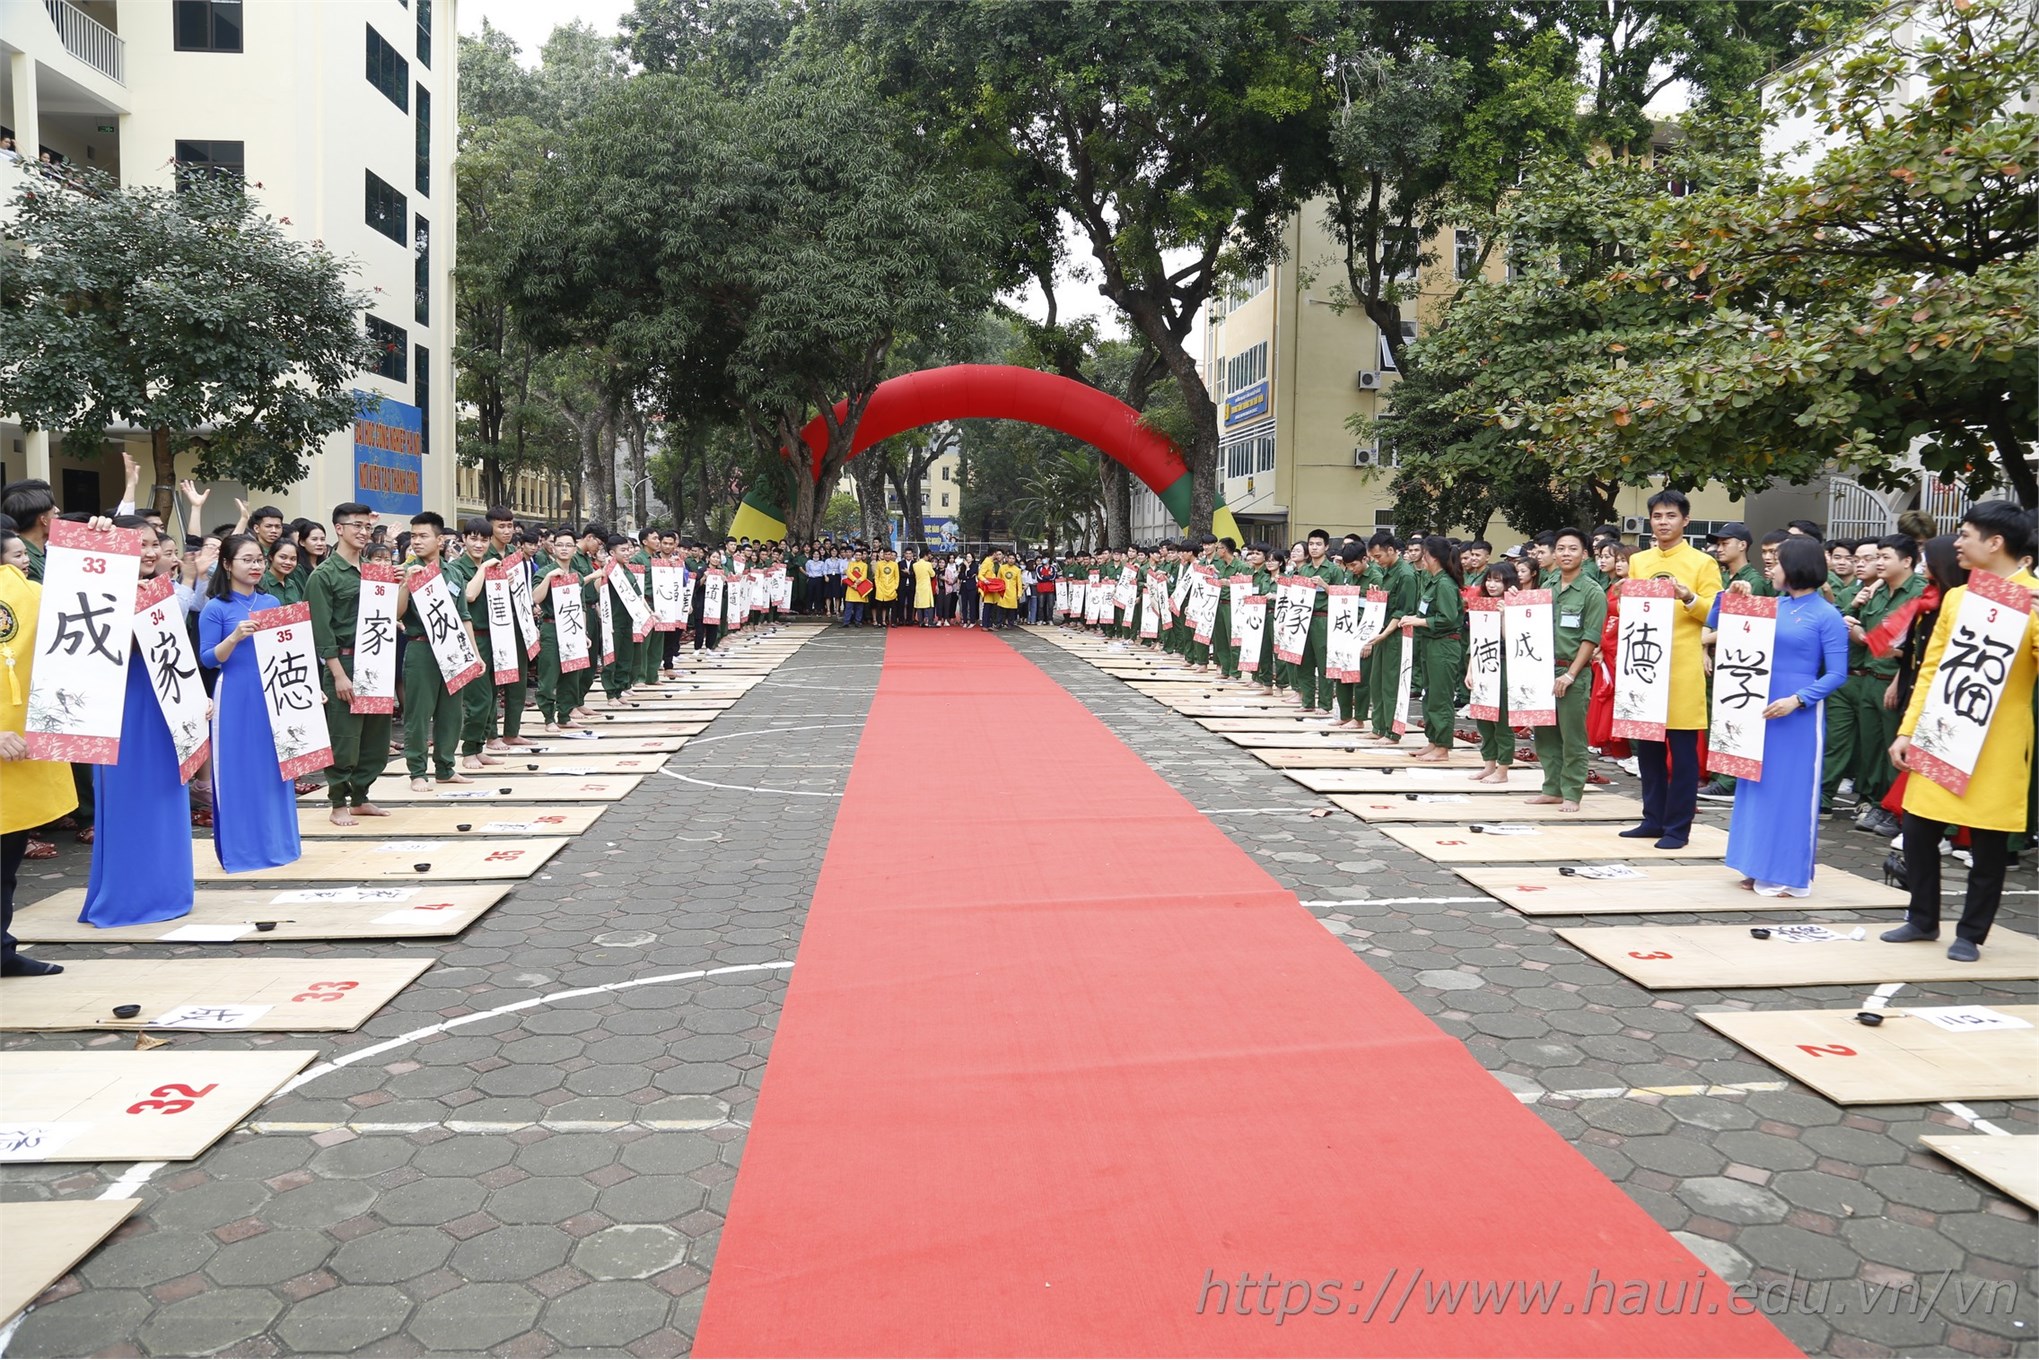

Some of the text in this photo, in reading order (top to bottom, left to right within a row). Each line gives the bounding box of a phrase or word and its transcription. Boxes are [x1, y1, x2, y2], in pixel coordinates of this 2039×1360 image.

[82, 556, 106, 575] 33
[374, 585, 385, 596] 36
[425, 584, 434, 596] 37
[494, 582, 502, 591] 38
[1341, 597, 1348, 605] 10
[1642, 601, 1650, 613] 5
[150, 609, 165, 626] 34
[559, 600, 582, 635] 家
[1483, 613, 1489, 623] 7
[1525, 608, 1532, 618] 6
[1986, 607, 1999, 623] 3
[45, 591, 124, 666] 成
[427, 598, 459, 645] 成
[1246, 615, 1262, 631] 心
[1332, 609, 1354, 635] 成
[1743, 620, 1751, 634] 4
[276, 629, 293, 644] 35
[361, 609, 394, 656] 家
[1514, 631, 1543, 662] 成
[150, 631, 197, 704] 家
[484, 850, 526, 862] 35
[1628, 950, 1673, 961] 3
[291, 980, 360, 1003] 33
[1797, 1043, 1858, 1058] 2
[126, 1083, 220, 1116] 32
